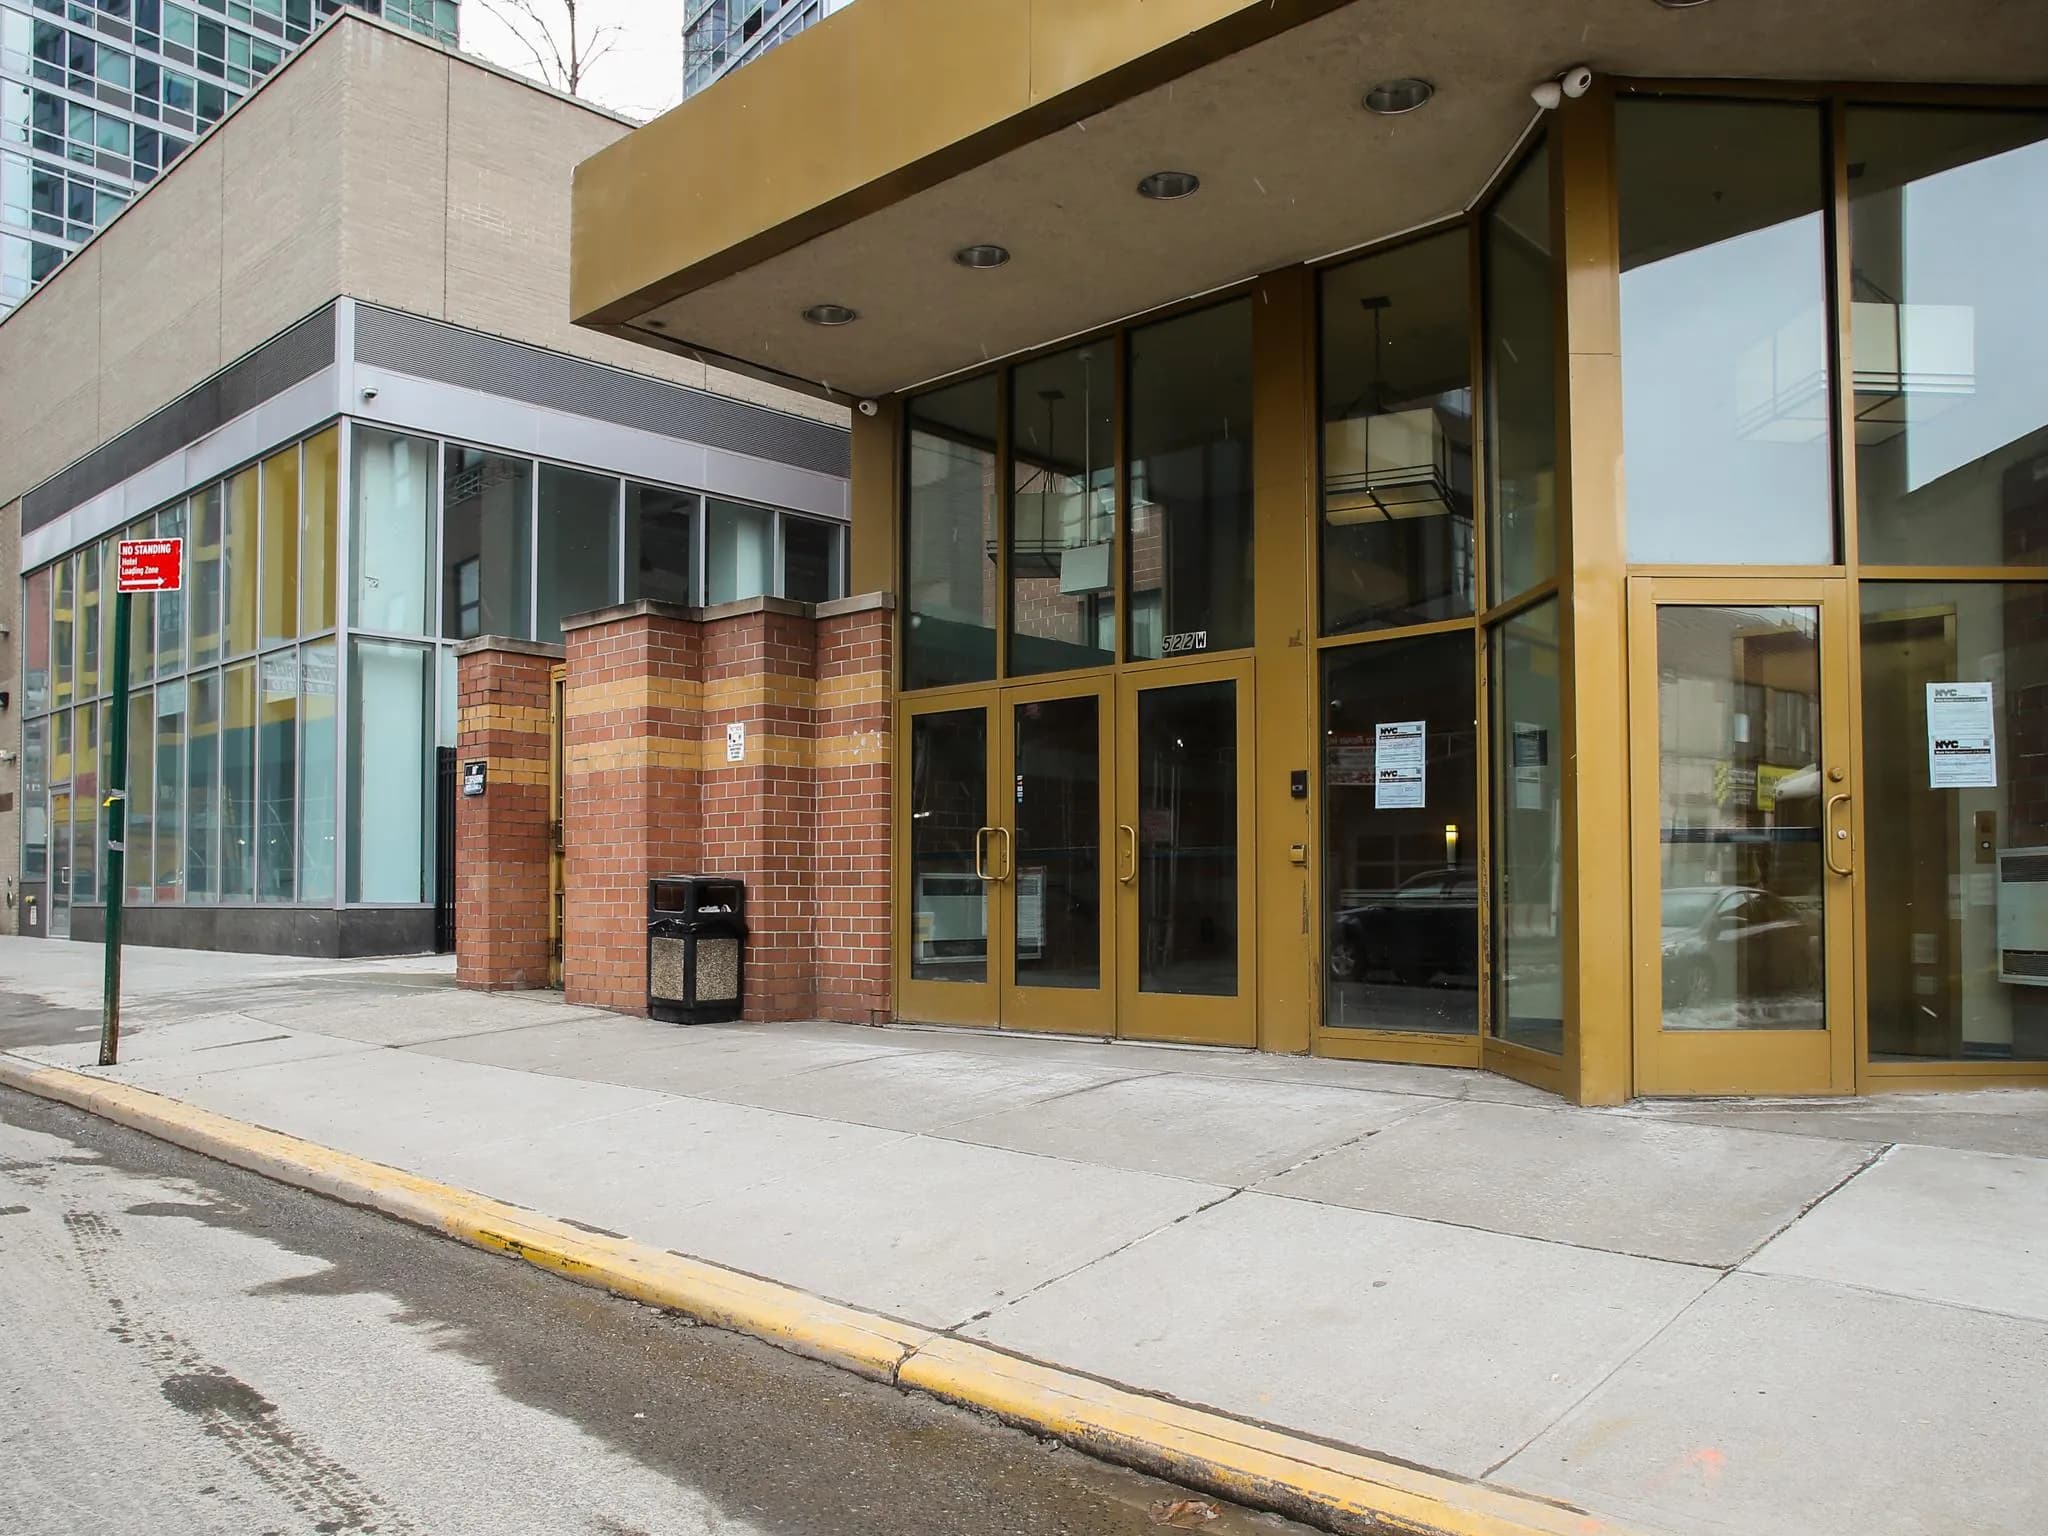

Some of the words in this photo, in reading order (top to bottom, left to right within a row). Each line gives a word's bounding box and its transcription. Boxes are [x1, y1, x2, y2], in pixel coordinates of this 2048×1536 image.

[122, 545, 133, 555] NO
[134, 543, 171, 554] STANDING
[122, 558, 137, 566] Hotel
[122, 567, 144, 576] Loading
[144, 566, 159, 574] Zone
[1935, 689, 1957, 697] NYC
[1380, 727, 1398, 735] NYC
[1935, 740, 1959, 749] NYC
[1380, 770, 1398, 778] NYC
